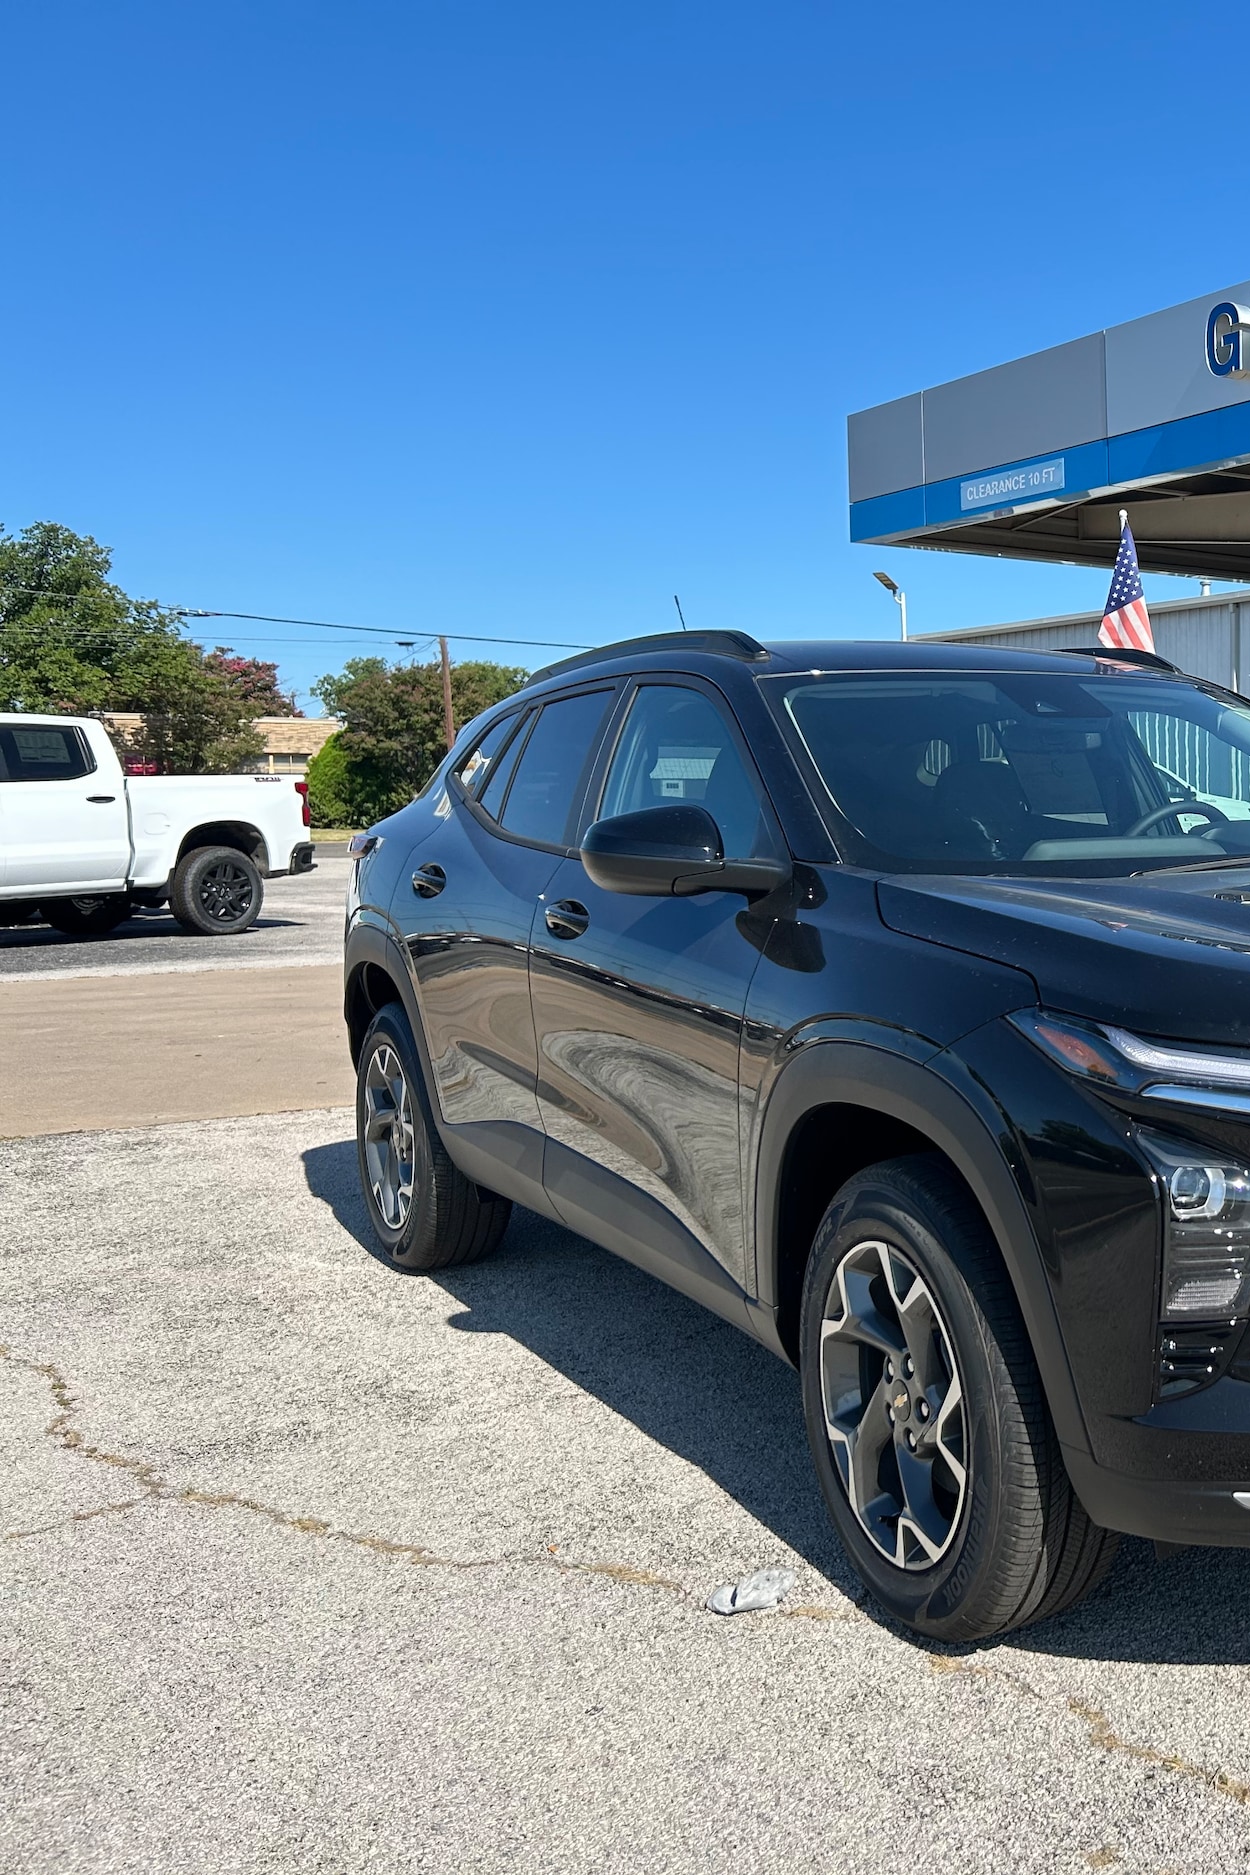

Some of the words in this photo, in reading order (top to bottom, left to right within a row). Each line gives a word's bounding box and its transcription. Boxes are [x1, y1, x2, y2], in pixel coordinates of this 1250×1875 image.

[967, 474, 1026, 500] CLEARANCE
[1028, 471, 1040, 486] 10
[1042, 467, 1056, 483] FT
